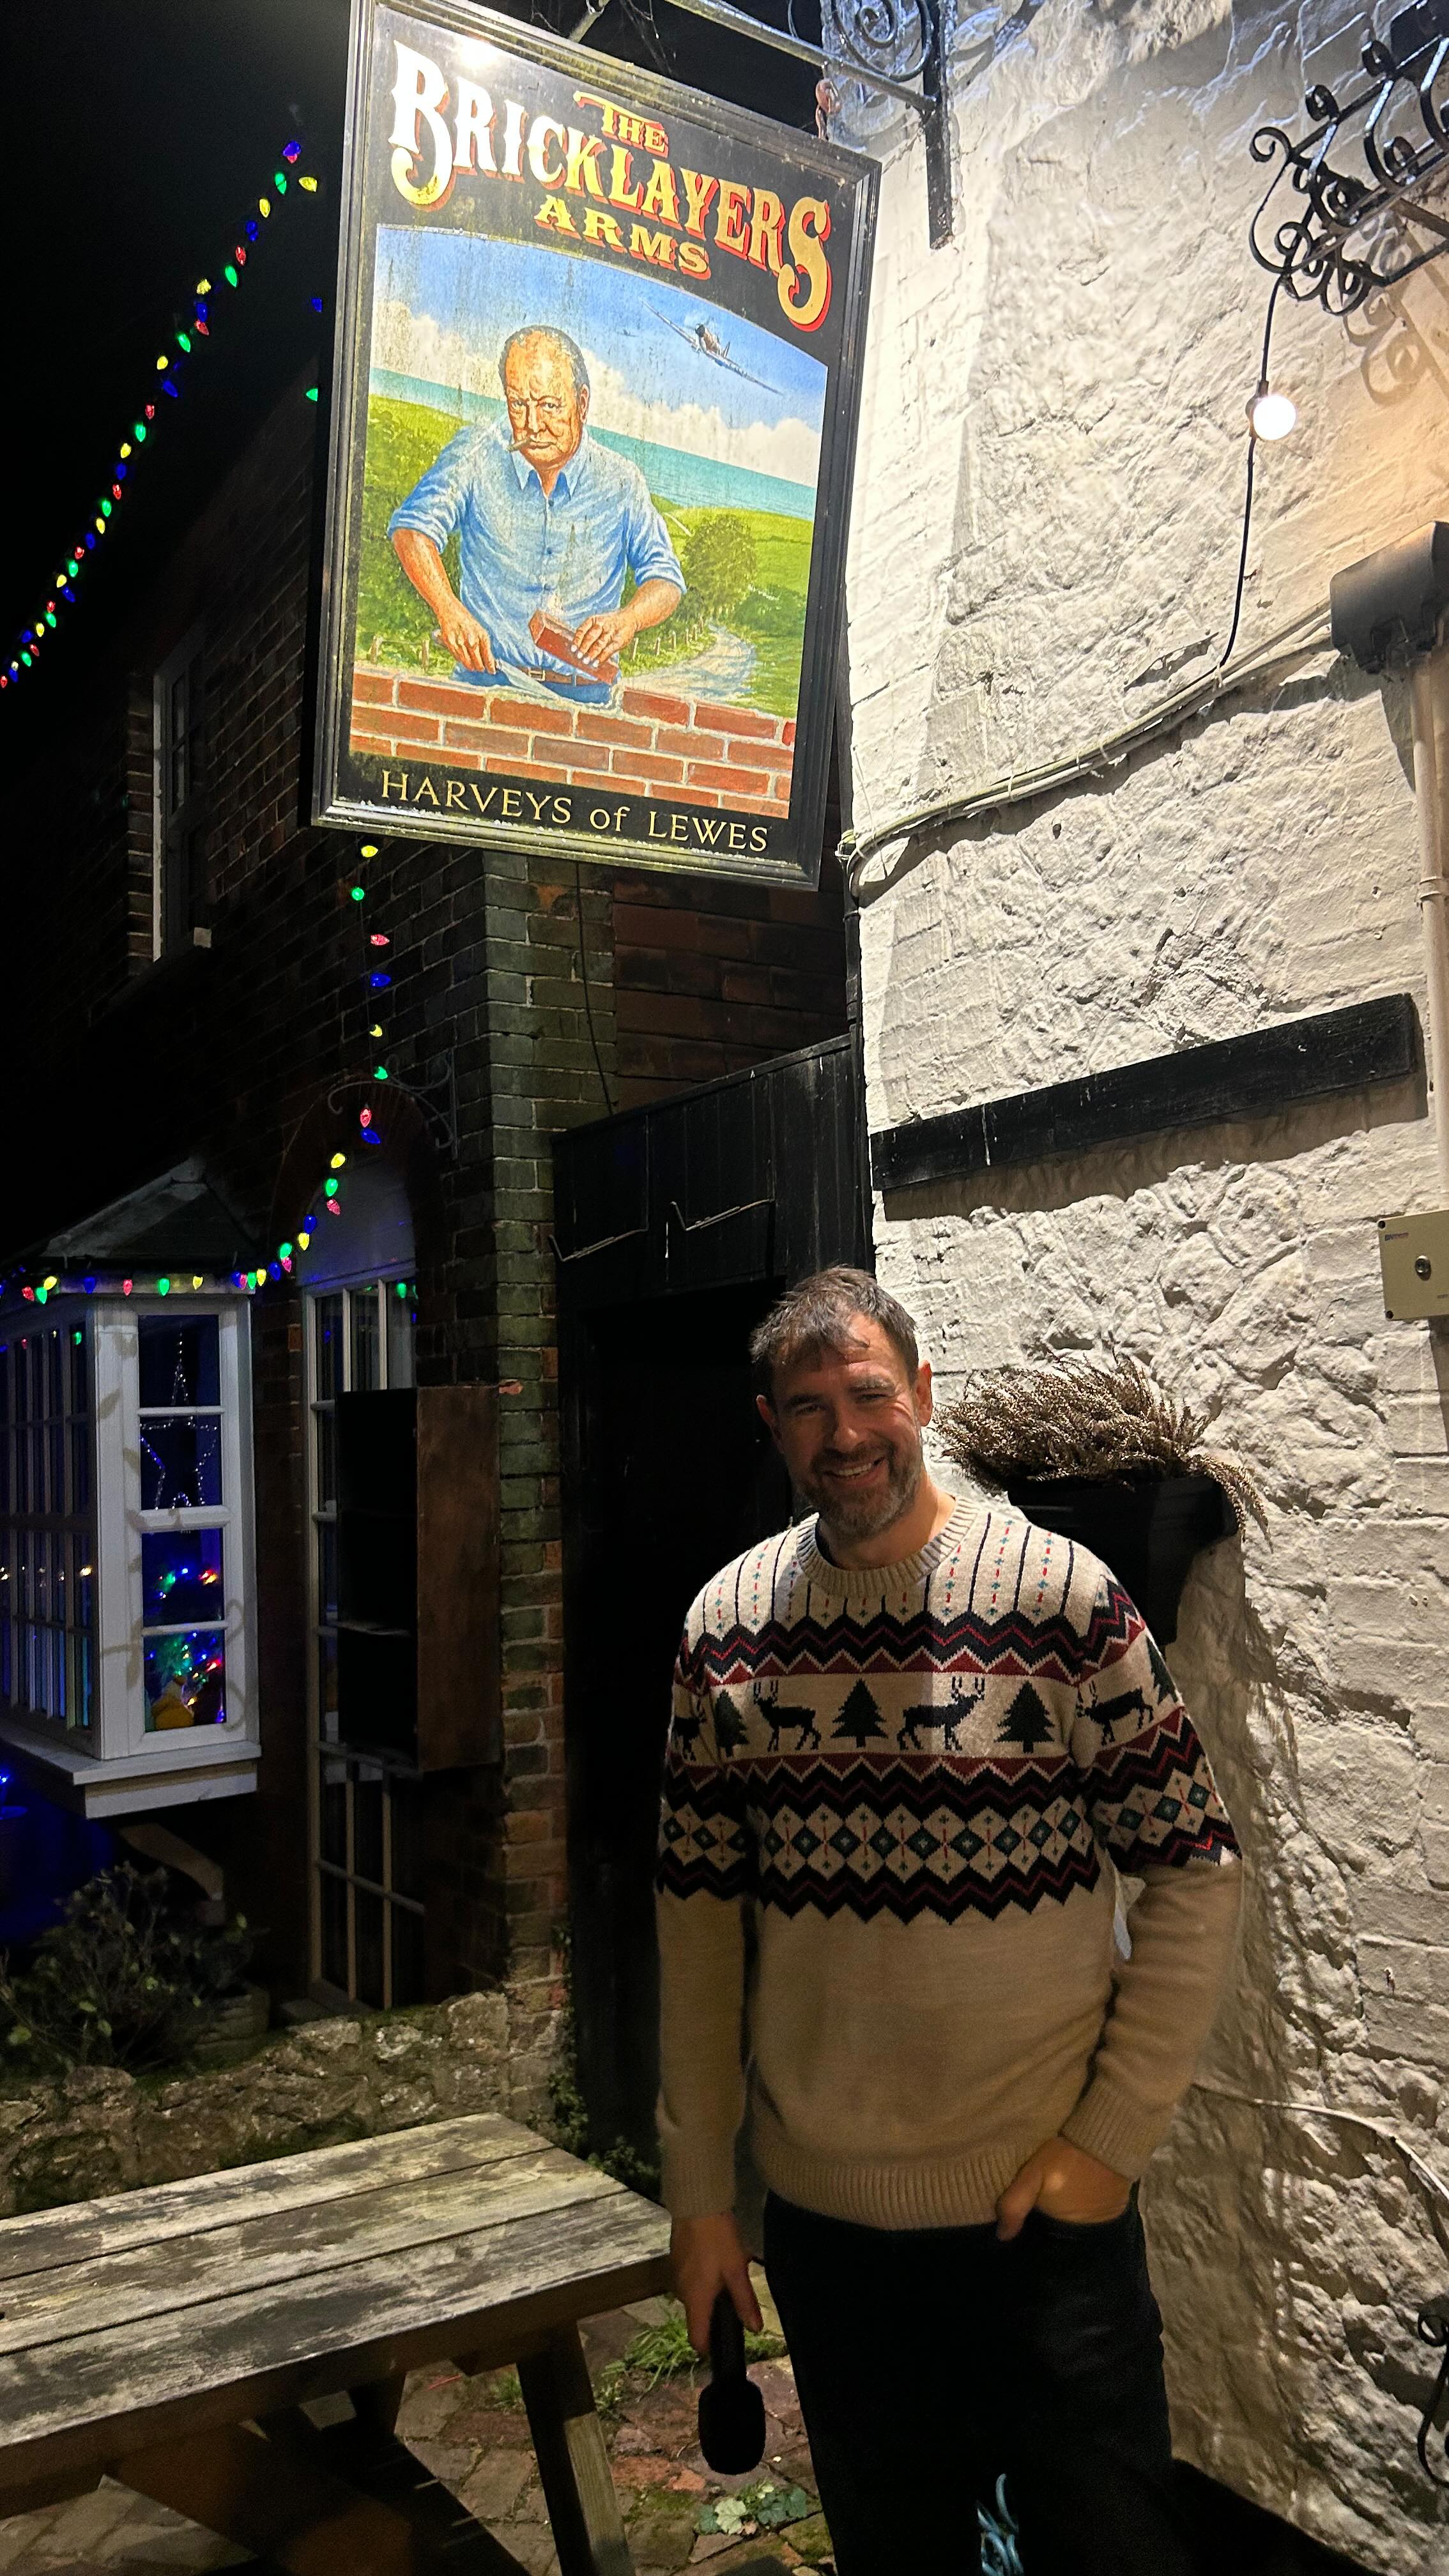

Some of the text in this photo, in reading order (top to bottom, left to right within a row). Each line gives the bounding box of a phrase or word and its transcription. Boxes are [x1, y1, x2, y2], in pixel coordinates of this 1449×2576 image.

[573, 90, 668, 157] THE
[388, 39, 832, 332] BRICKLAYERS
[534, 194, 711, 280] ARMS
[381, 770, 768, 852] HARVEYS of LEWES
